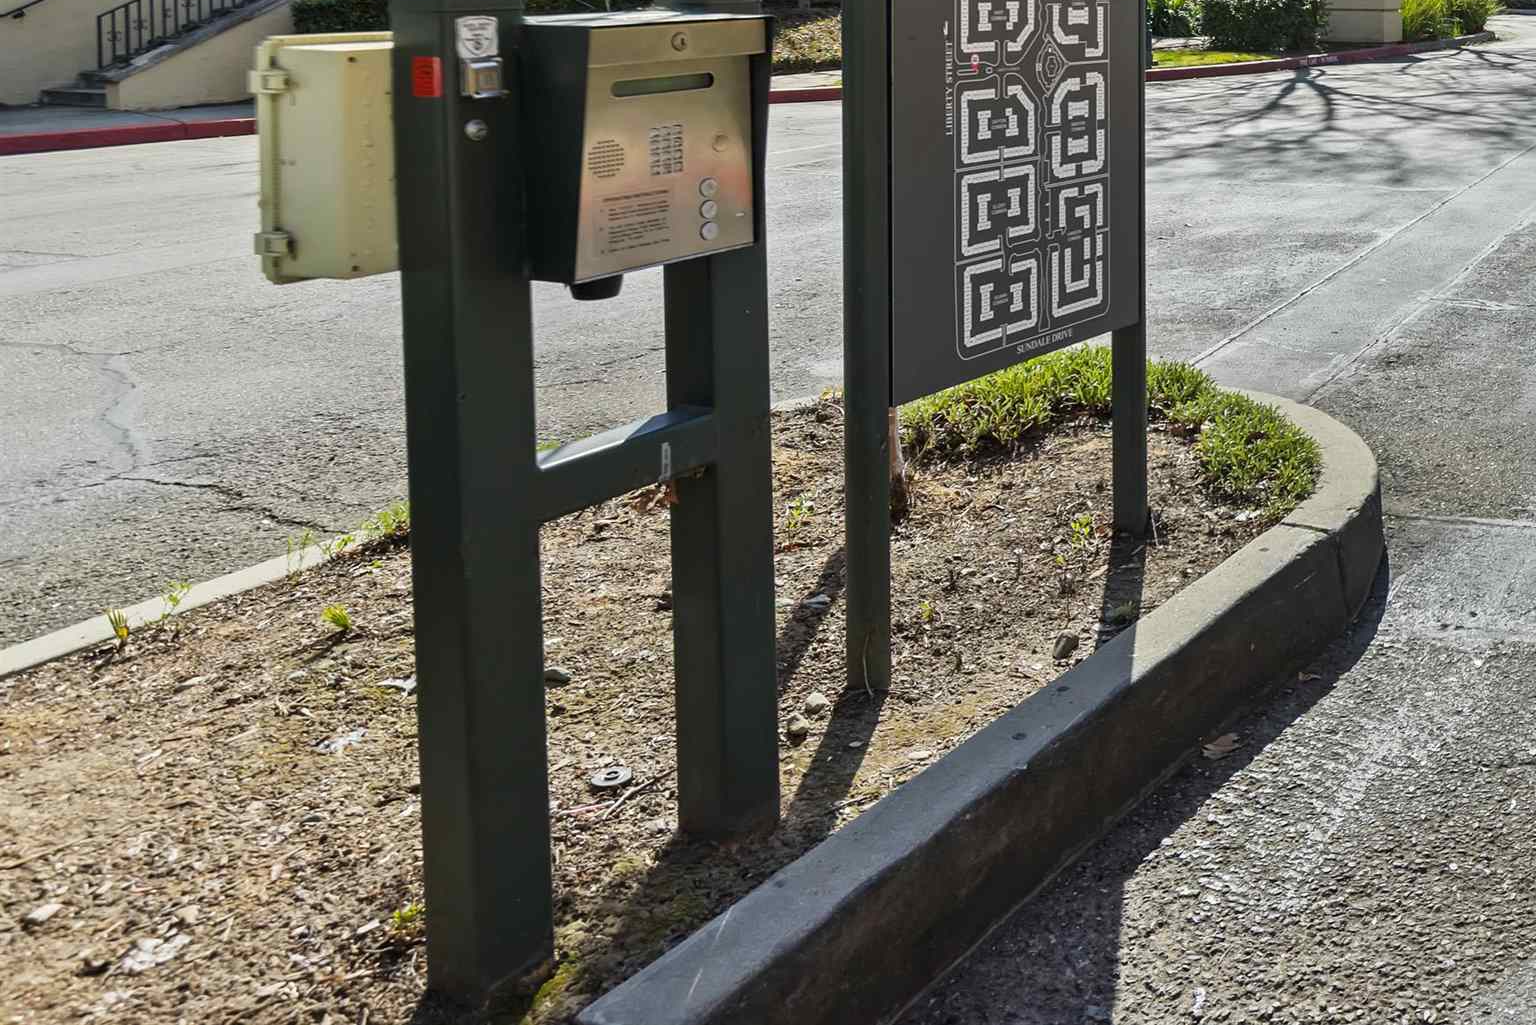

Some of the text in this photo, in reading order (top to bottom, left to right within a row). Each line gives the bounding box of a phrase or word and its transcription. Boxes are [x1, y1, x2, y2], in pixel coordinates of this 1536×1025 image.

[944, 40, 953, 136] LIBERTY STREET
[1051, 327, 1073, 344] DRIVE
